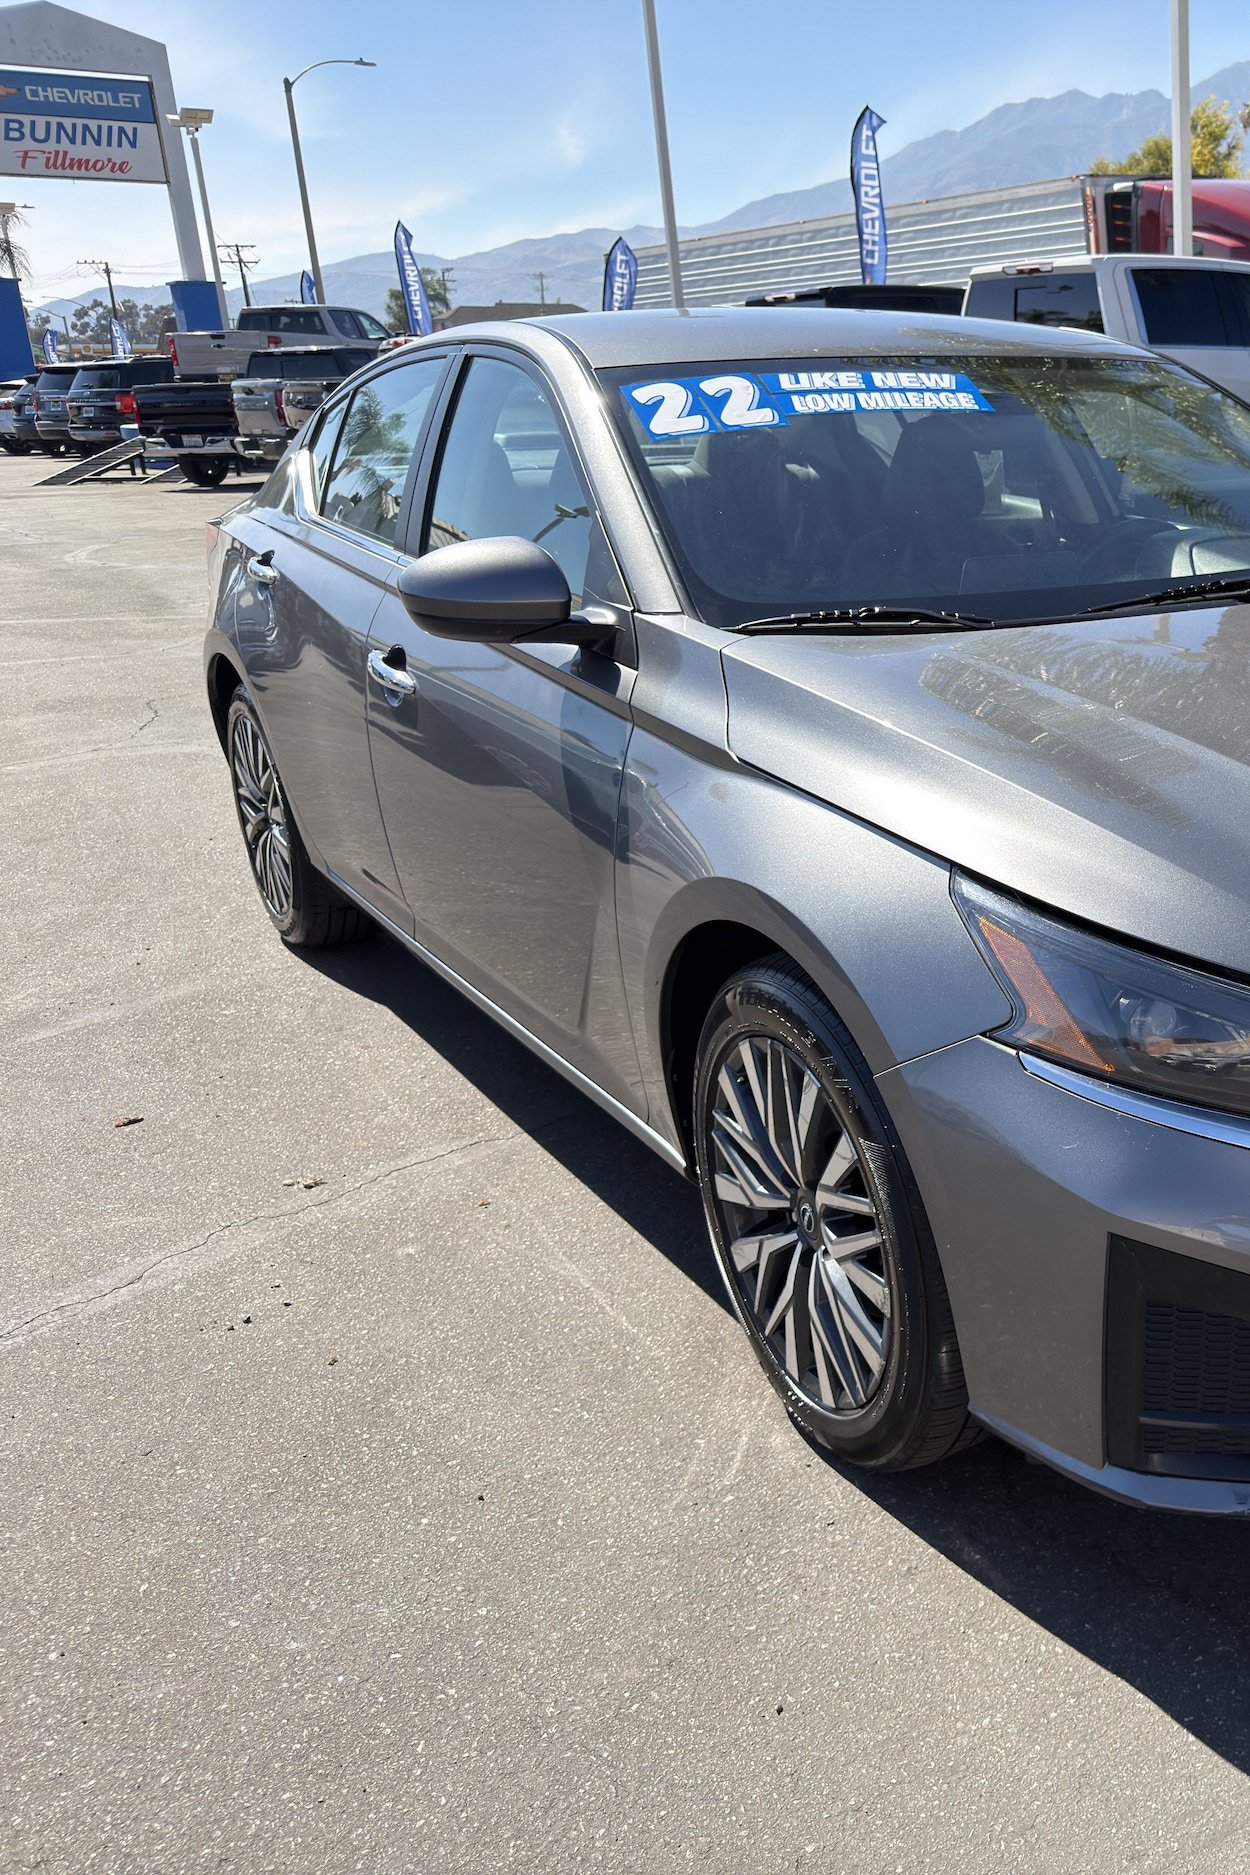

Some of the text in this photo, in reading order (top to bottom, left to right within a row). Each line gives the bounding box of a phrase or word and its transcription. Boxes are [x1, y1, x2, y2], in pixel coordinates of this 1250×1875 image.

[25, 86, 141, 108] CHEVROLET
[4, 118, 137, 149] BUNNIN
[13, 150, 132, 174] Fillmore
[631, 373, 956, 435] 22 LIKE NEW
[791, 392, 979, 412] LOW MILEAGE
